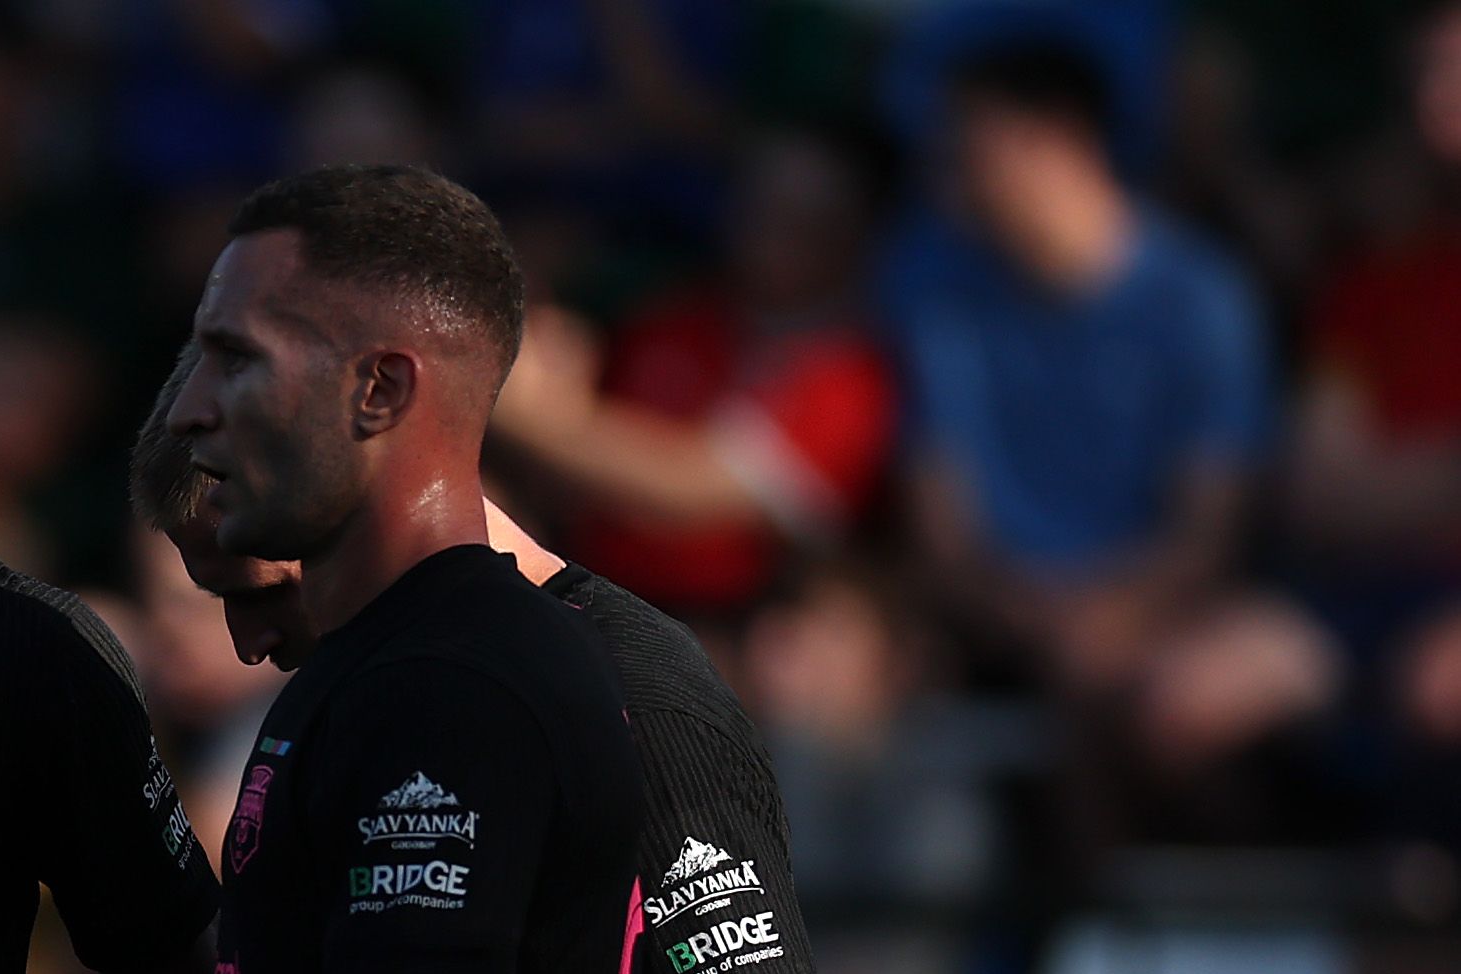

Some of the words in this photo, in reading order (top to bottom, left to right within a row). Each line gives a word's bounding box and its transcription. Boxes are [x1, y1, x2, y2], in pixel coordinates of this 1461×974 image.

[349, 859, 471, 897] BRIDGE
[643, 860, 761, 925] SLAVYANKA
[665, 911, 780, 974] BRIDGE
[719, 956, 733, 972] of
[734, 945, 784, 966] companies
